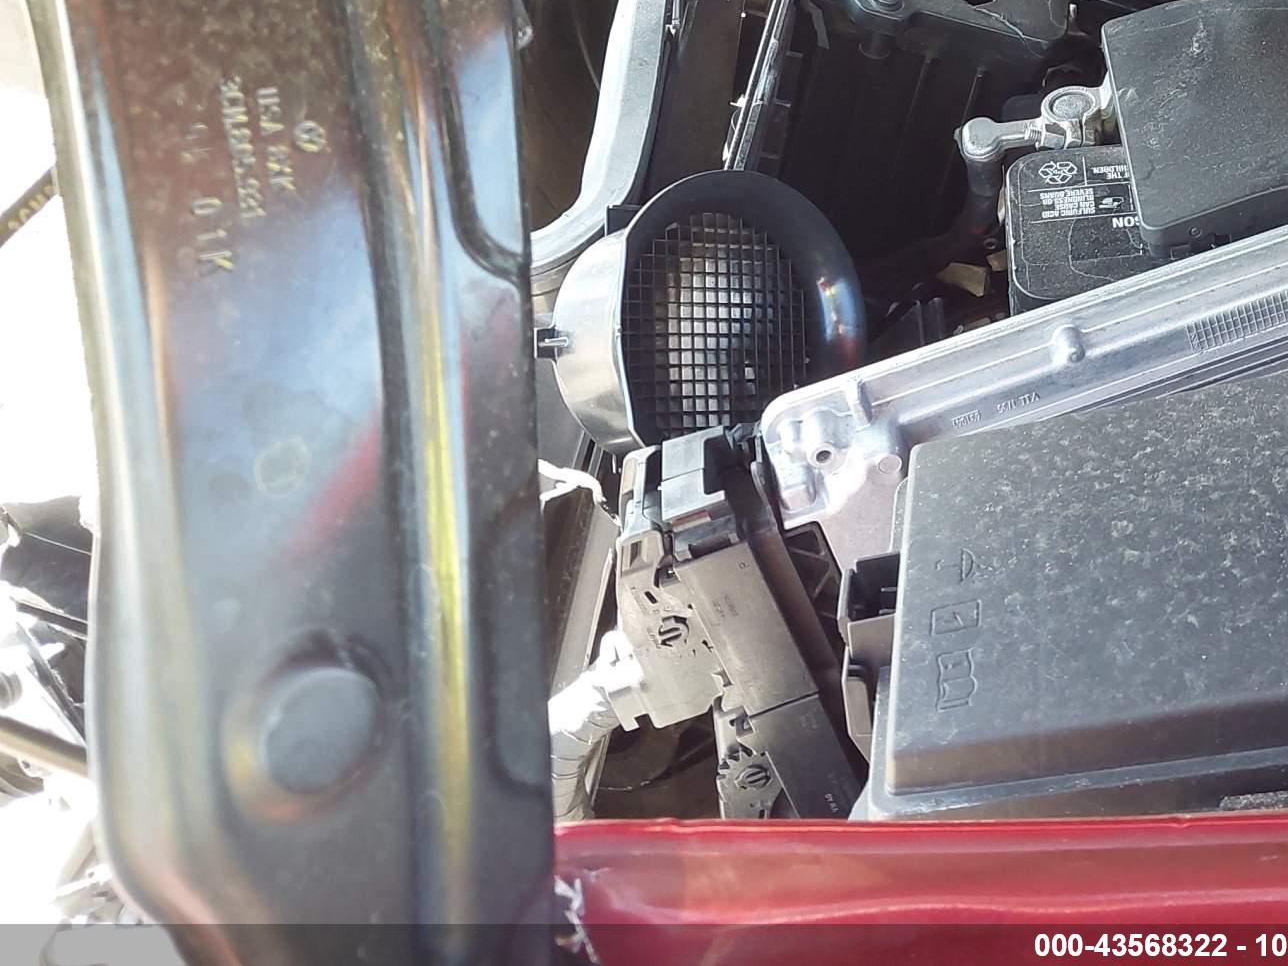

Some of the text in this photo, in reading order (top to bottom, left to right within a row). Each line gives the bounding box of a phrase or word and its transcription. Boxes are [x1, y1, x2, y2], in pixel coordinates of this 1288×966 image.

[1106, 172, 1121, 180] THE
[1039, 188, 1094, 199] SEVERE BURNS
[1054, 195, 1094, 204] BLINDNESS
[1055, 201, 1095, 210] CAN CAUSE
[1042, 206, 1096, 218] SULFURIC ACID
